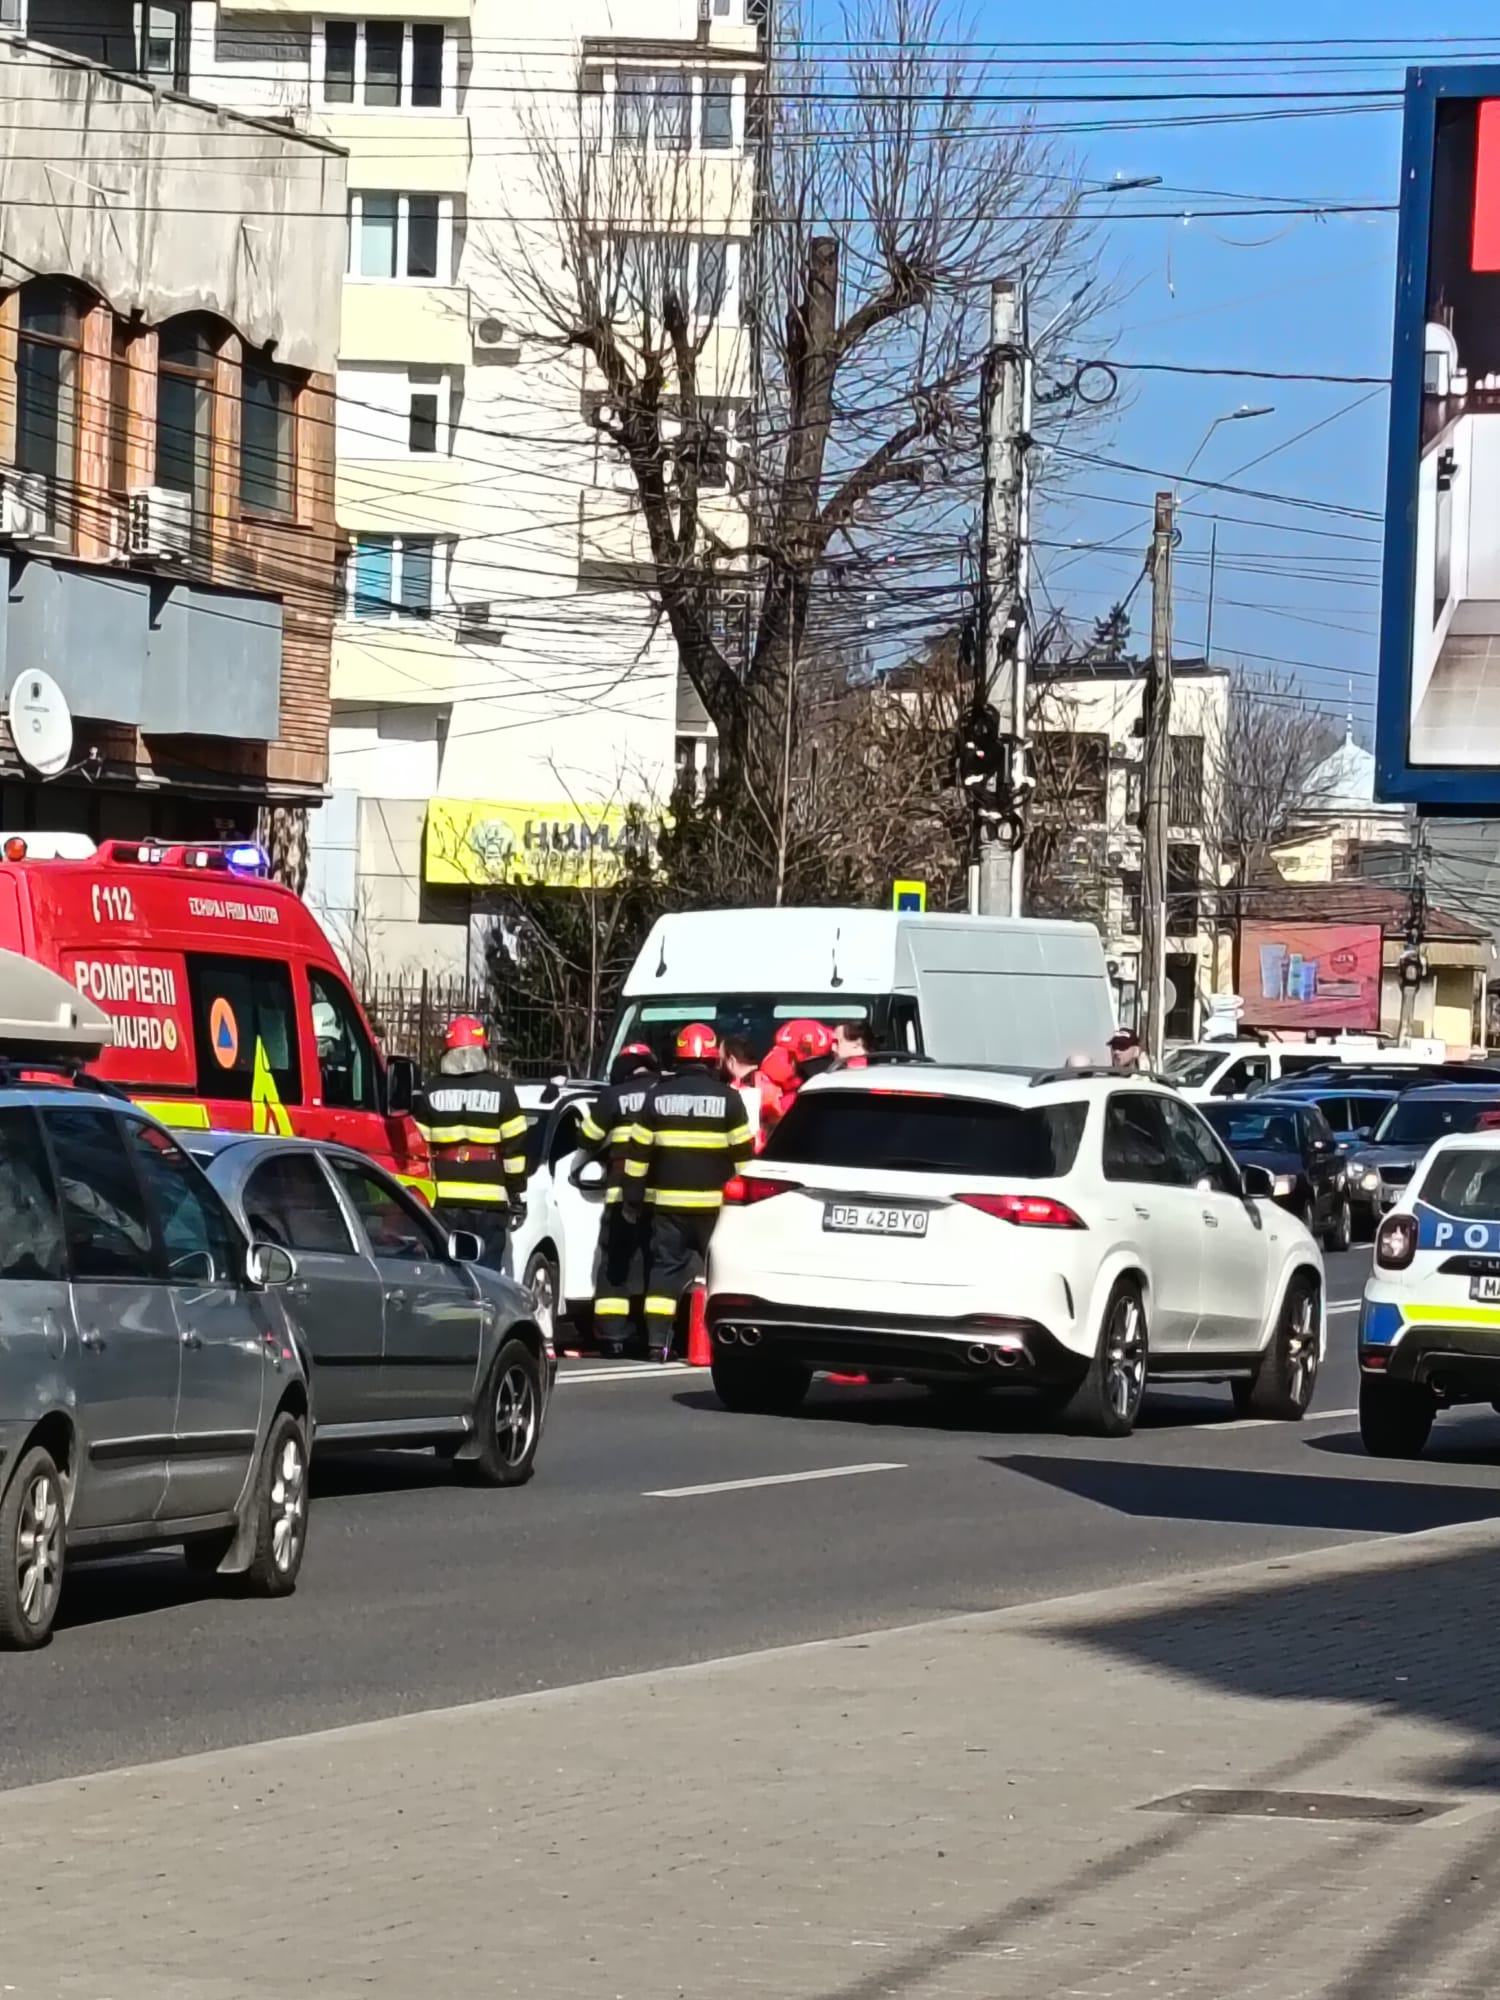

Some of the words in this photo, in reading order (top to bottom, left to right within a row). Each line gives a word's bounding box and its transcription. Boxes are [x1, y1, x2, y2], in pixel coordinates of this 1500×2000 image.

[102, 887, 135, 921] 112
[74, 961, 176, 1005] POMPIERII
[105, 1015, 162, 1050] MURD
[834, 1207, 858, 1225] DB
